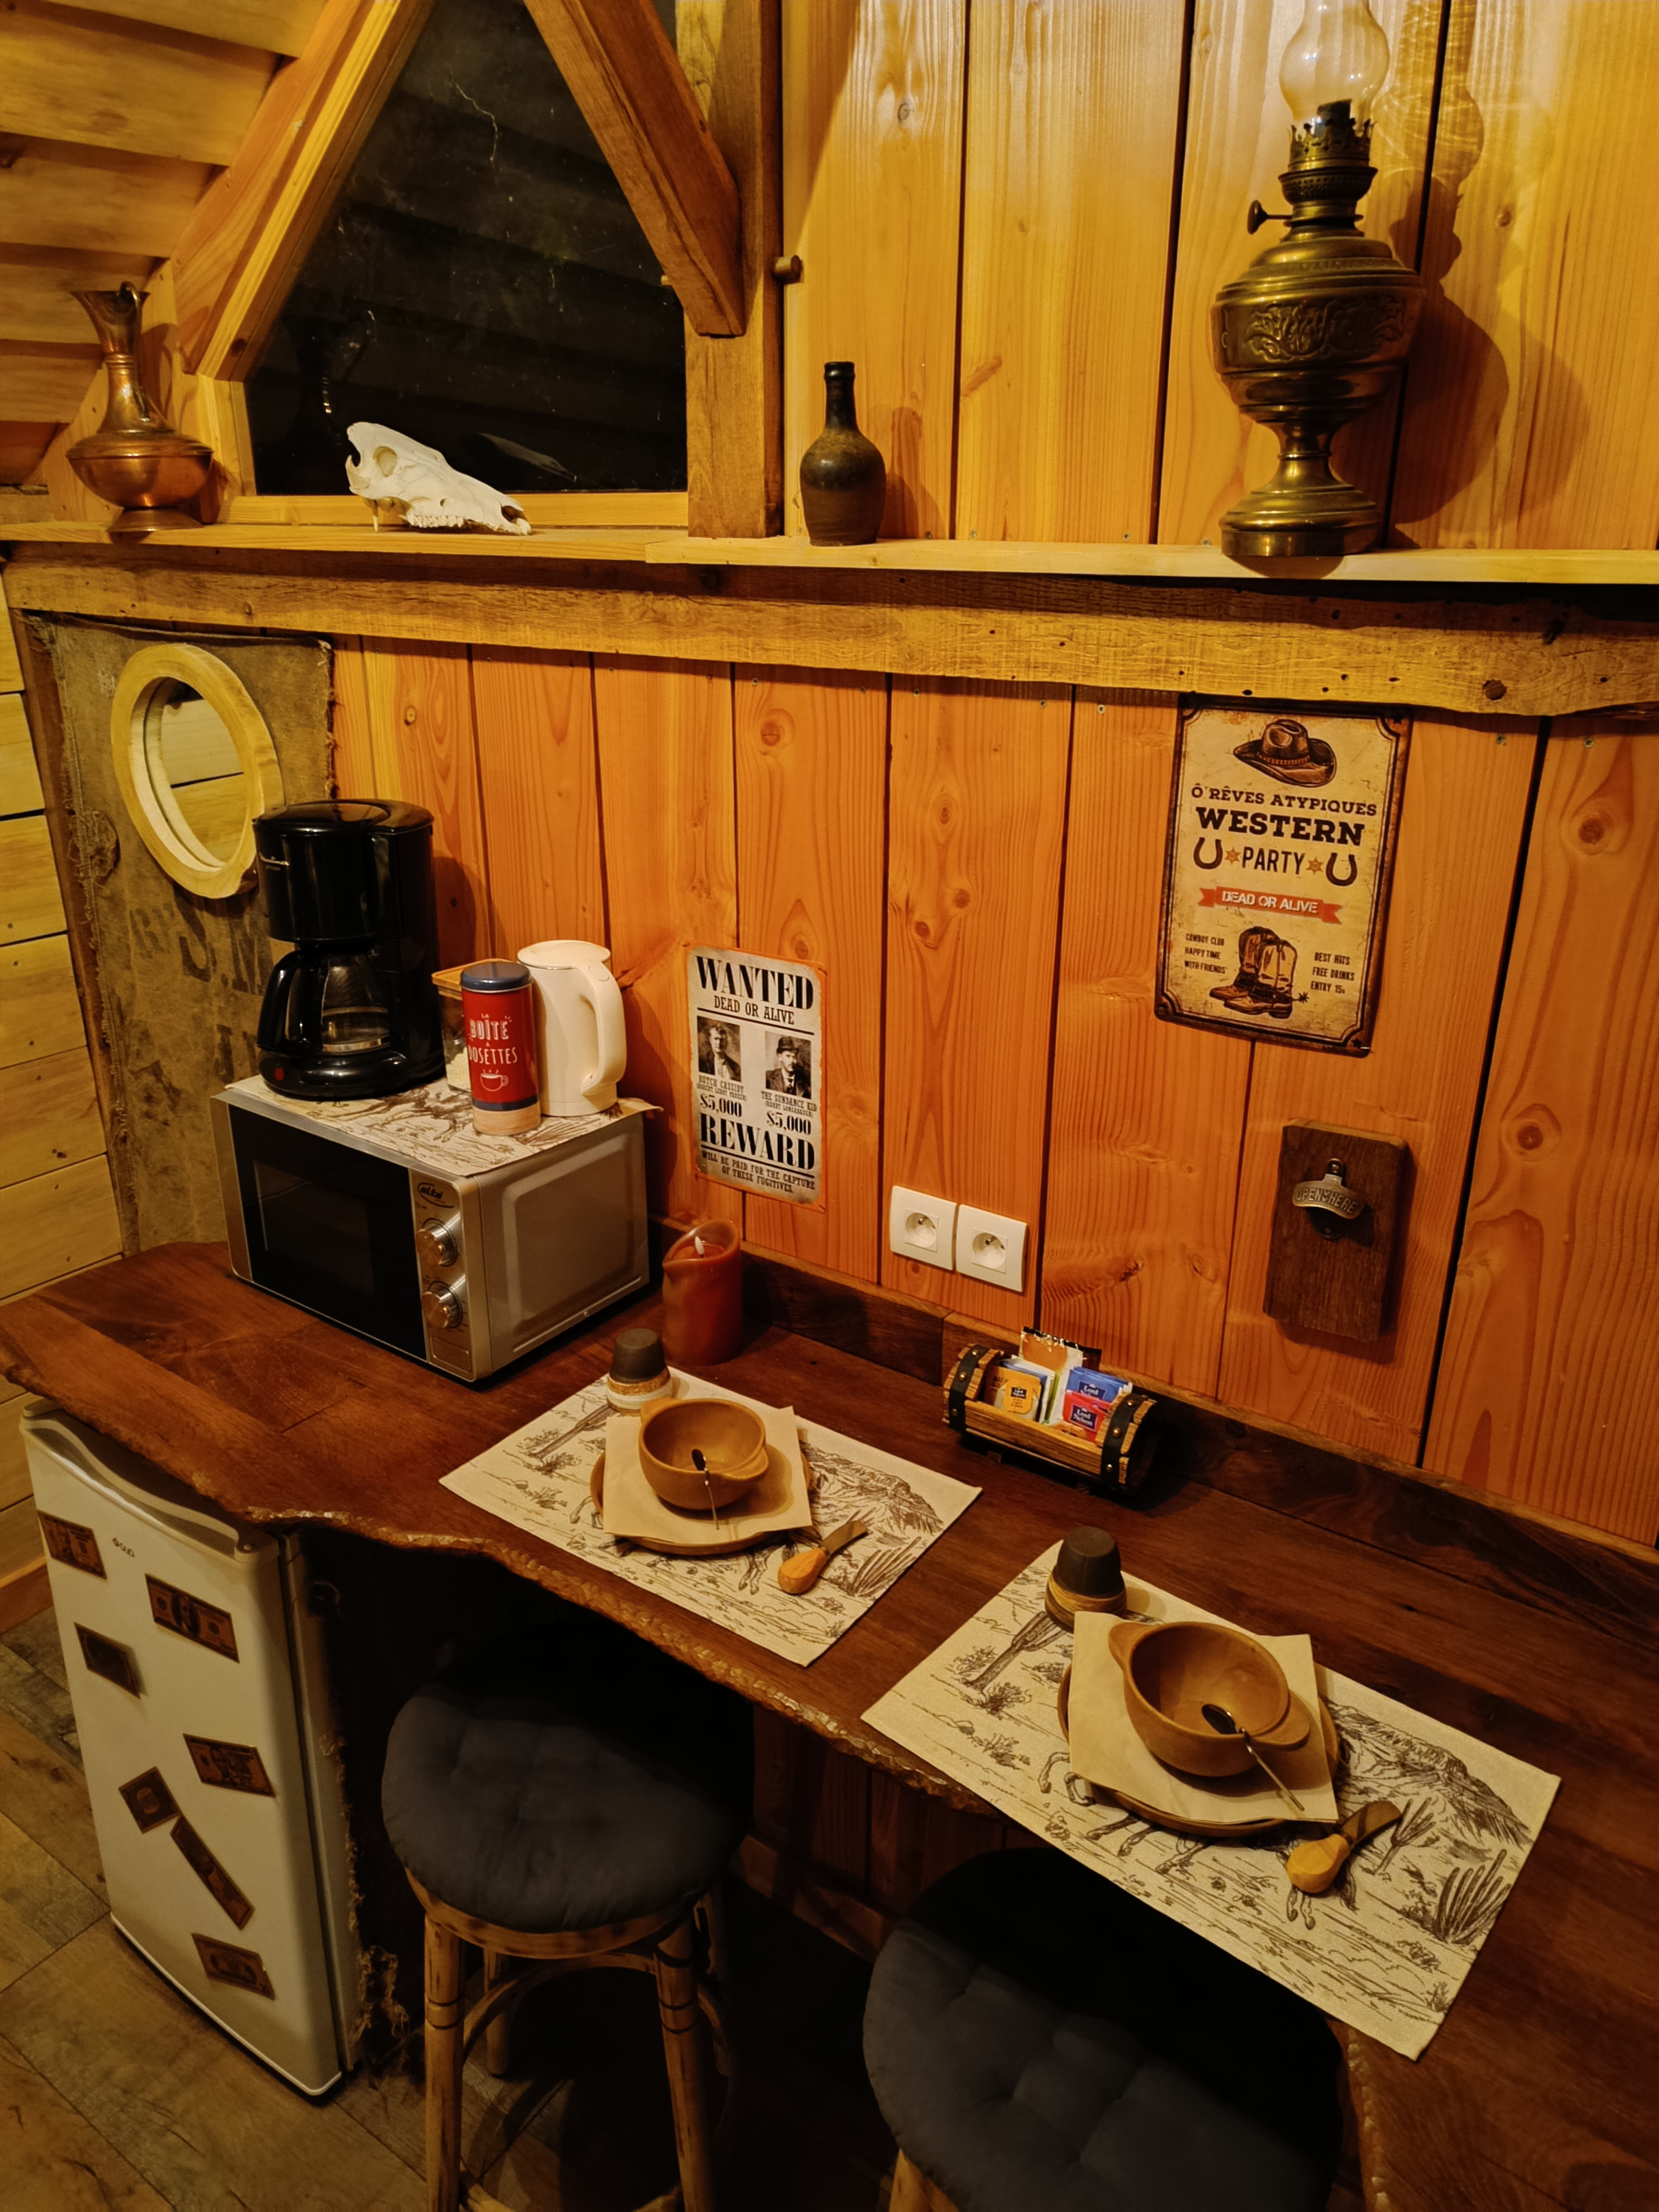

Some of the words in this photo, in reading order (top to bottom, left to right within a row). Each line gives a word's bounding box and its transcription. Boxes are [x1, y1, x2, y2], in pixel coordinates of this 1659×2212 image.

[1209, 785, 1264, 804] RÊVES
[1271, 794, 1377, 816] ATYPIQUES
[1196, 806, 1365, 846] WESTERN
[1242, 846, 1305, 875] PARTY
[1222, 891, 1255, 905] DEAD
[1258, 896, 1277, 908] OR
[1280, 899, 1318, 913] ALIVE
[1314, 952, 1331, 963] BEST
[1334, 955, 1351, 966] HITS
[696, 955, 814, 1010] WANTED
[1312, 967, 1328, 977] FREE
[1330, 969, 1355, 981] DRINKS
[1310, 981, 1332, 992] ENTRY
[714, 995, 740, 1013] DEAD
[745, 1002, 759, 1017] OR
[764, 1006, 794, 1024] ALIVE
[700, 1112, 815, 1170] REWARD
[702, 1149, 718, 1163] WILL
[721, 1156, 729, 1165] BE
[732, 1159, 748, 1171] PAID
[751, 1164, 764, 1176] FOR
[766, 1169, 780, 1180] THE
[783, 1174, 815, 1190] CAPTURE
[722, 1165, 731, 1175] OF
[732, 1169, 753, 1182] THESE
[1296, 1188, 1323, 1201] OPEN
[1328, 1191, 1358, 1214] HERE
[1083, 1385, 1099, 1396] Lord
[1073, 1413, 1093, 1426] Nelson
[1077, 1408, 1091, 1420] Lord
